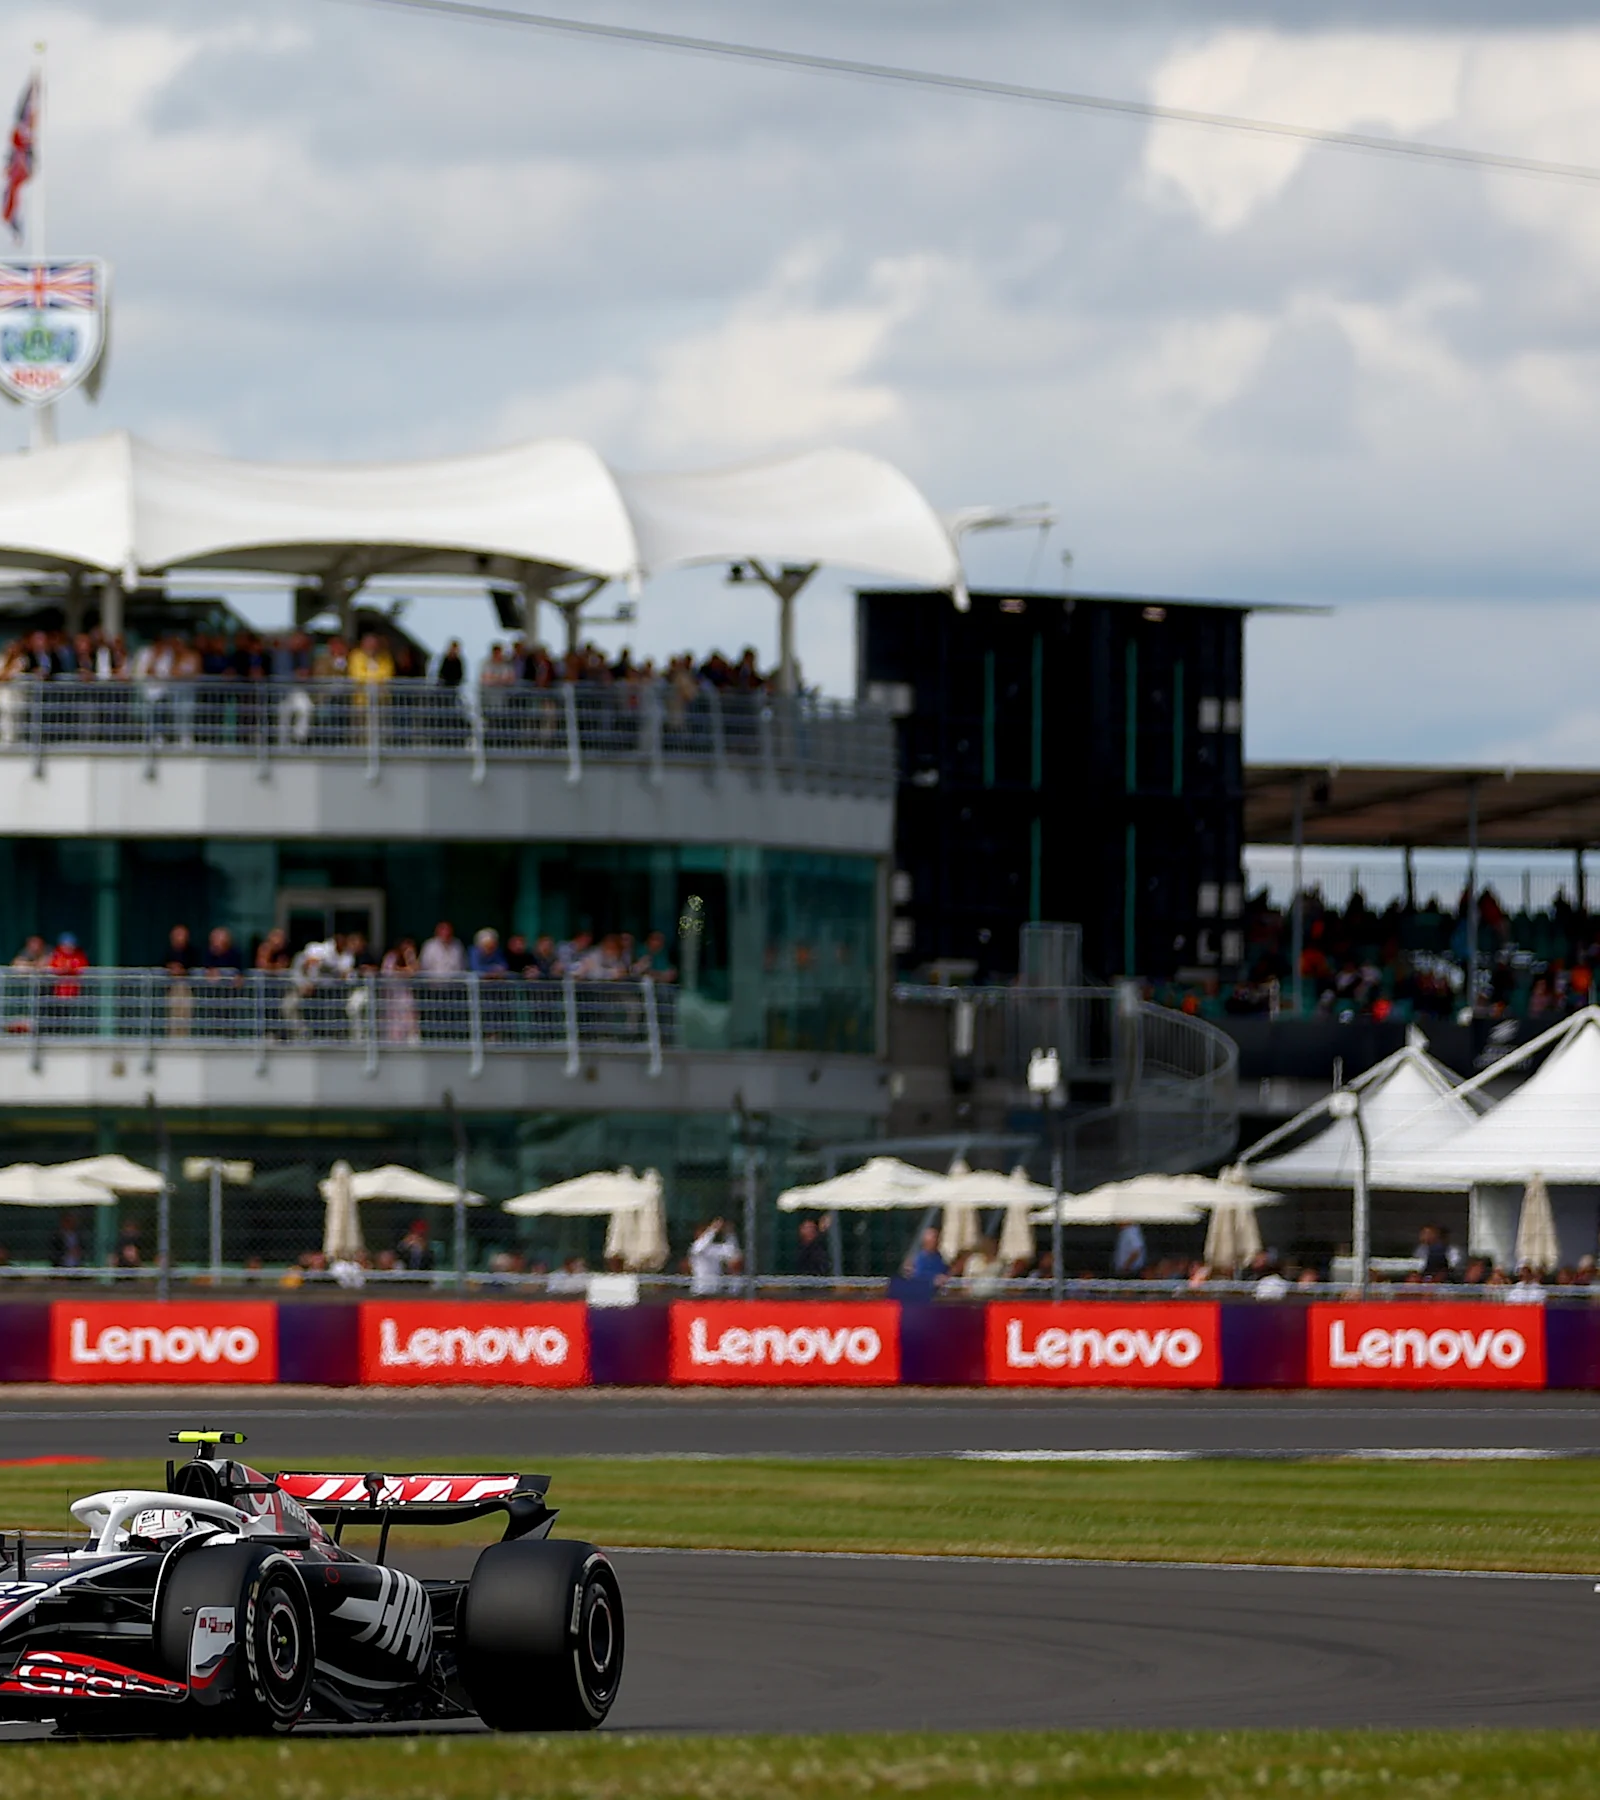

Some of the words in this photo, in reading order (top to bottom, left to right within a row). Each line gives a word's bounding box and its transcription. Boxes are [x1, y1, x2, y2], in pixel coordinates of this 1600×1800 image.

[71, 1318, 259, 1364] Lenovo
[379, 1319, 569, 1367] Lenovo
[689, 1318, 881, 1367] Lenovo
[1006, 1319, 1202, 1368] Lenovo
[1329, 1319, 1525, 1368] Lenovo
[246, 1599, 259, 1682] ZERO
